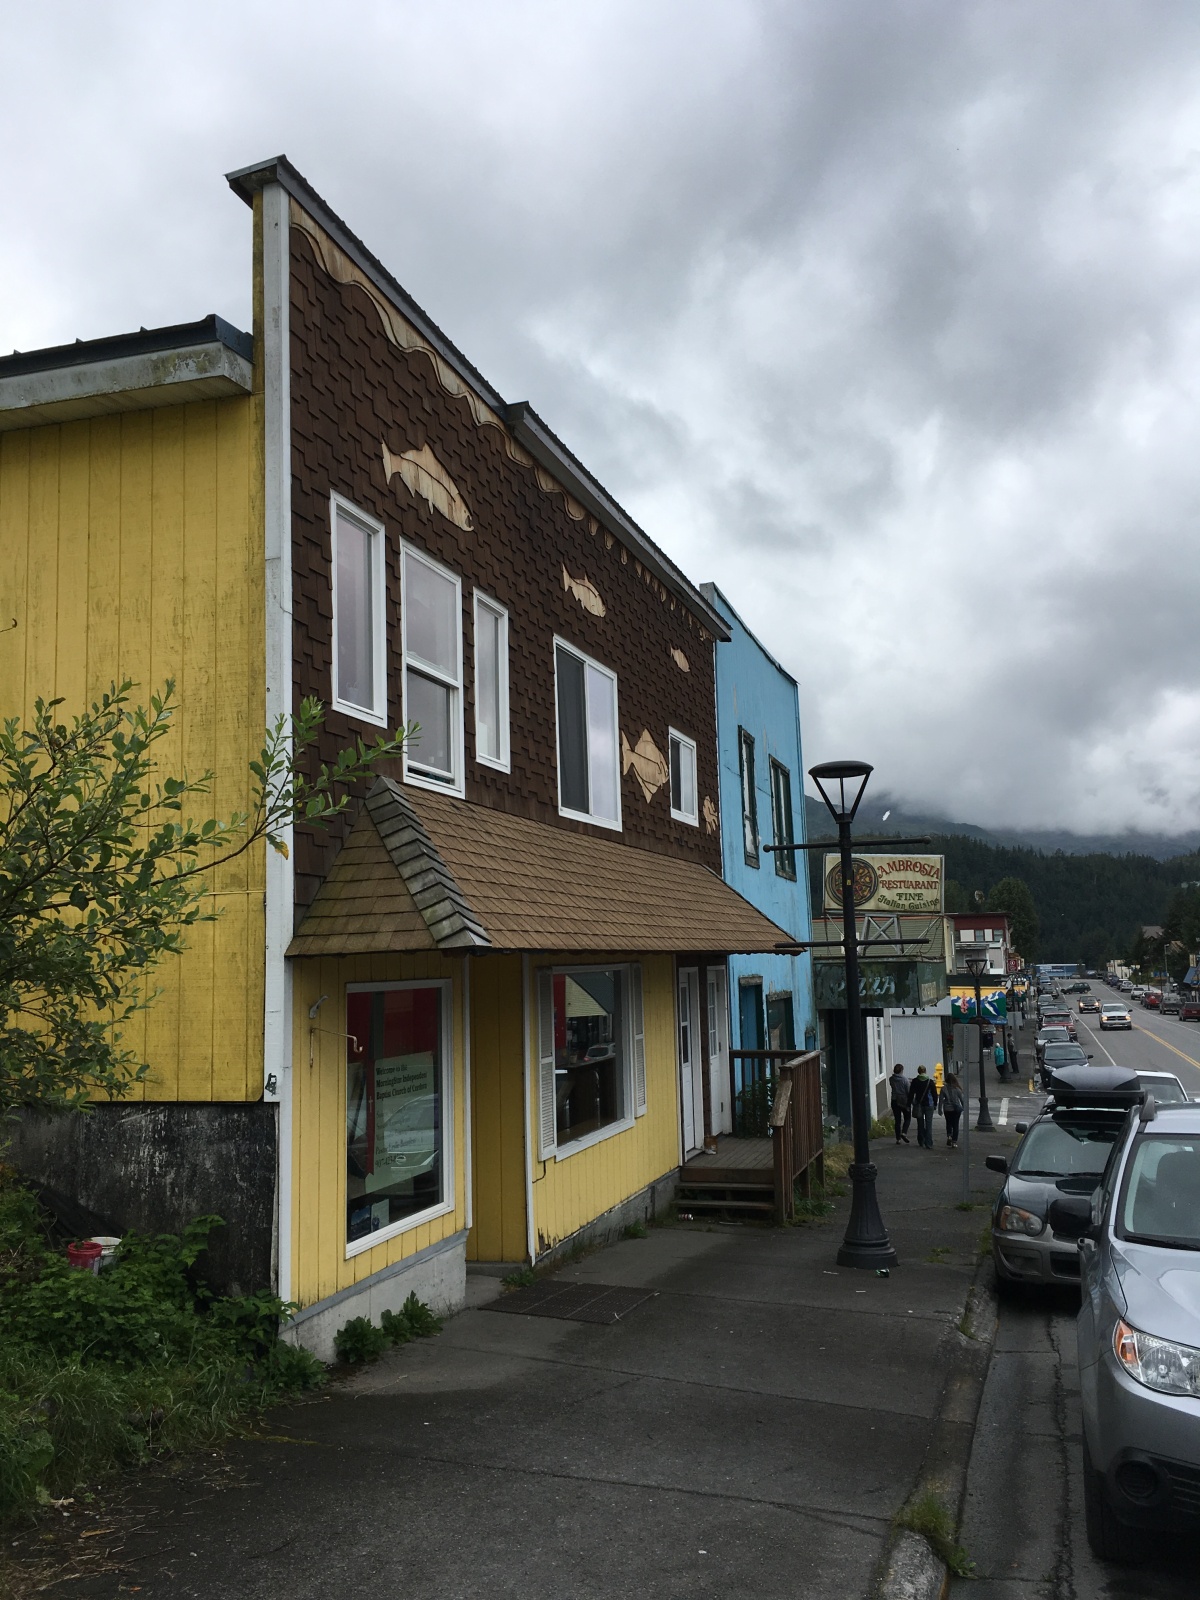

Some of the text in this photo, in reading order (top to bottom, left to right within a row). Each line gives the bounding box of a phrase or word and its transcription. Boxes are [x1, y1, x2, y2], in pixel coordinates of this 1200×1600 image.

[877, 859, 940, 879] AMBROSIA
[880, 880, 939, 890] RESTUARANT
[877, 894, 906, 910] Italian
[896, 893, 924, 901] FINE
[392, 1086, 407, 1097] Church
